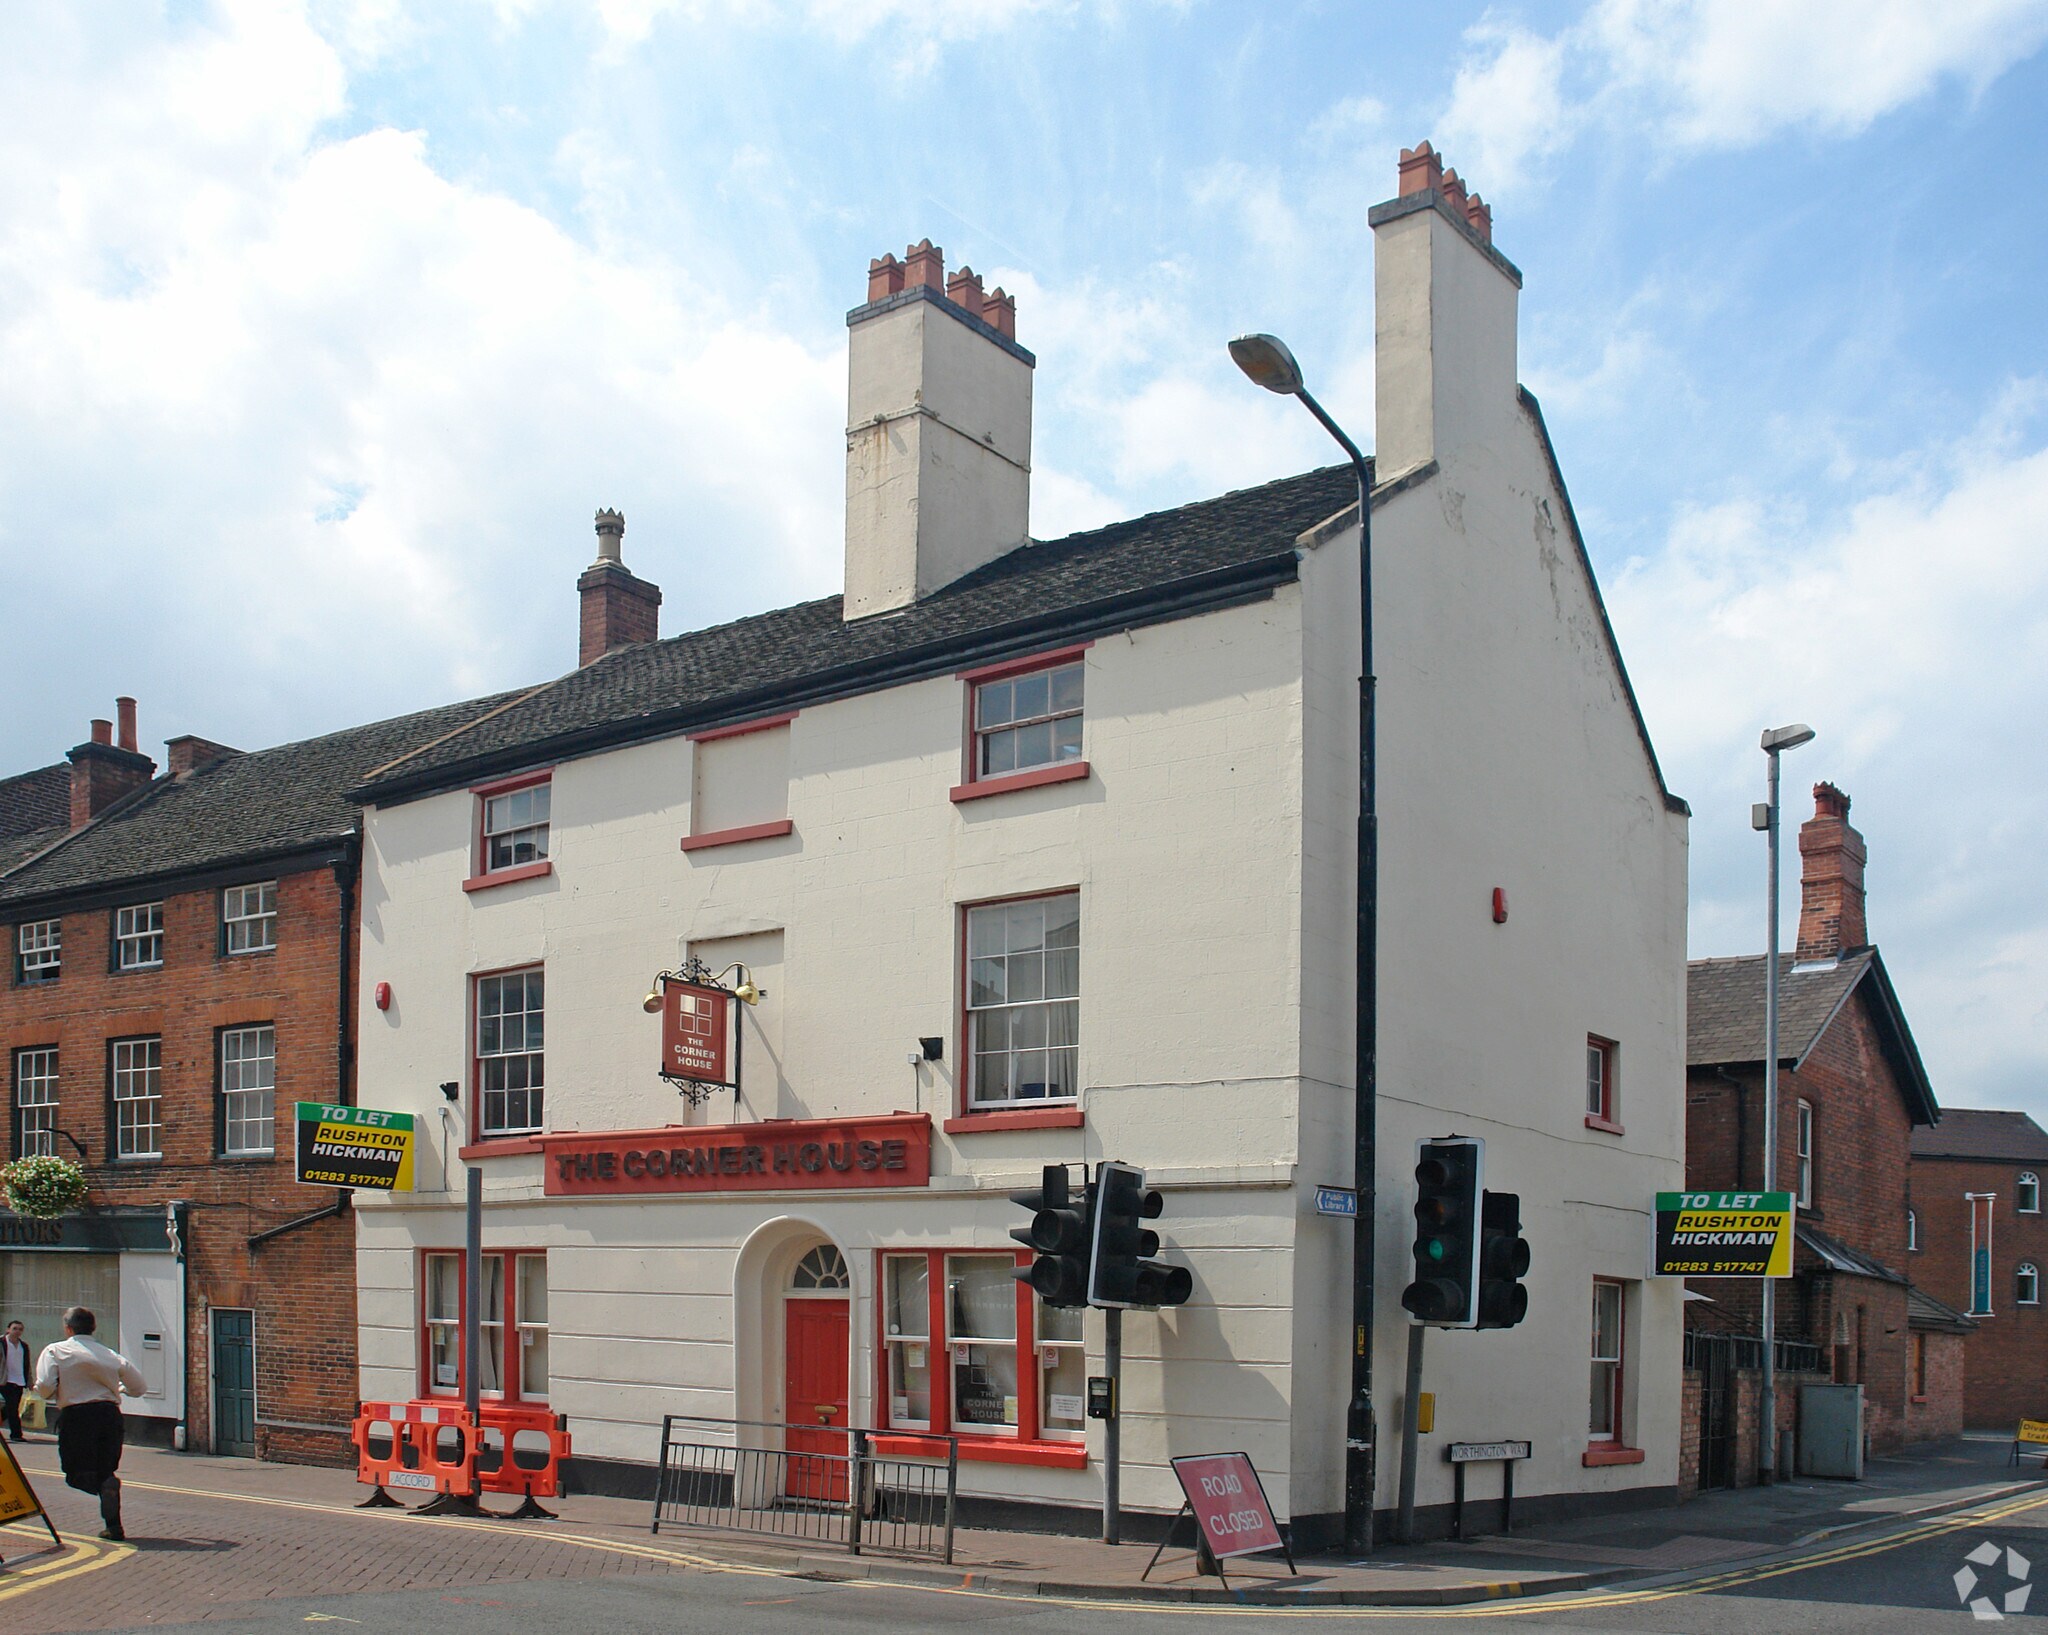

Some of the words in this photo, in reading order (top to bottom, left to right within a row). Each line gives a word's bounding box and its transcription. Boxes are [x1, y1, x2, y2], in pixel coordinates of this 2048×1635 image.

[687, 1037, 704, 1047] THE
[674, 1045, 716, 1060] CORNER
[677, 1056, 713, 1070] HOUSE
[321, 1106, 348, 1121] TO
[354, 1110, 393, 1126] LET
[318, 1128, 407, 1147] RUSHTON
[311, 1143, 402, 1162] HICKMAN
[555, 1151, 617, 1180] THE
[622, 1144, 767, 1178] CORNER
[771, 1138, 906, 1174] HOUSE
[305, 1170, 346, 1182] 01283
[348, 1174, 394, 1187] 517747
[1325, 1192, 1345, 1201] Public
[1679, 1194, 1710, 1209] TO
[1718, 1194, 1763, 1209] LET
[1324, 1201, 1345, 1211] Library
[1679, 1215, 1782, 1228] RUSHTON
[1671, 1232, 1776, 1245] HICKMAN
[1663, 1262, 1709, 1272] 01283
[1713, 1262, 1766, 1272] 517747
[981, 1390, 996, 1398] THE
[967, 1399, 1005, 1409] CORNE
[1452, 1445, 1507, 1459] WORTHINGTON
[1510, 1443, 1527, 1455] WAY
[394, 1474, 430, 1487] ACCORD
[1200, 1474, 1242, 1497] ROAD
[1210, 1509, 1264, 1536] CLOSED
